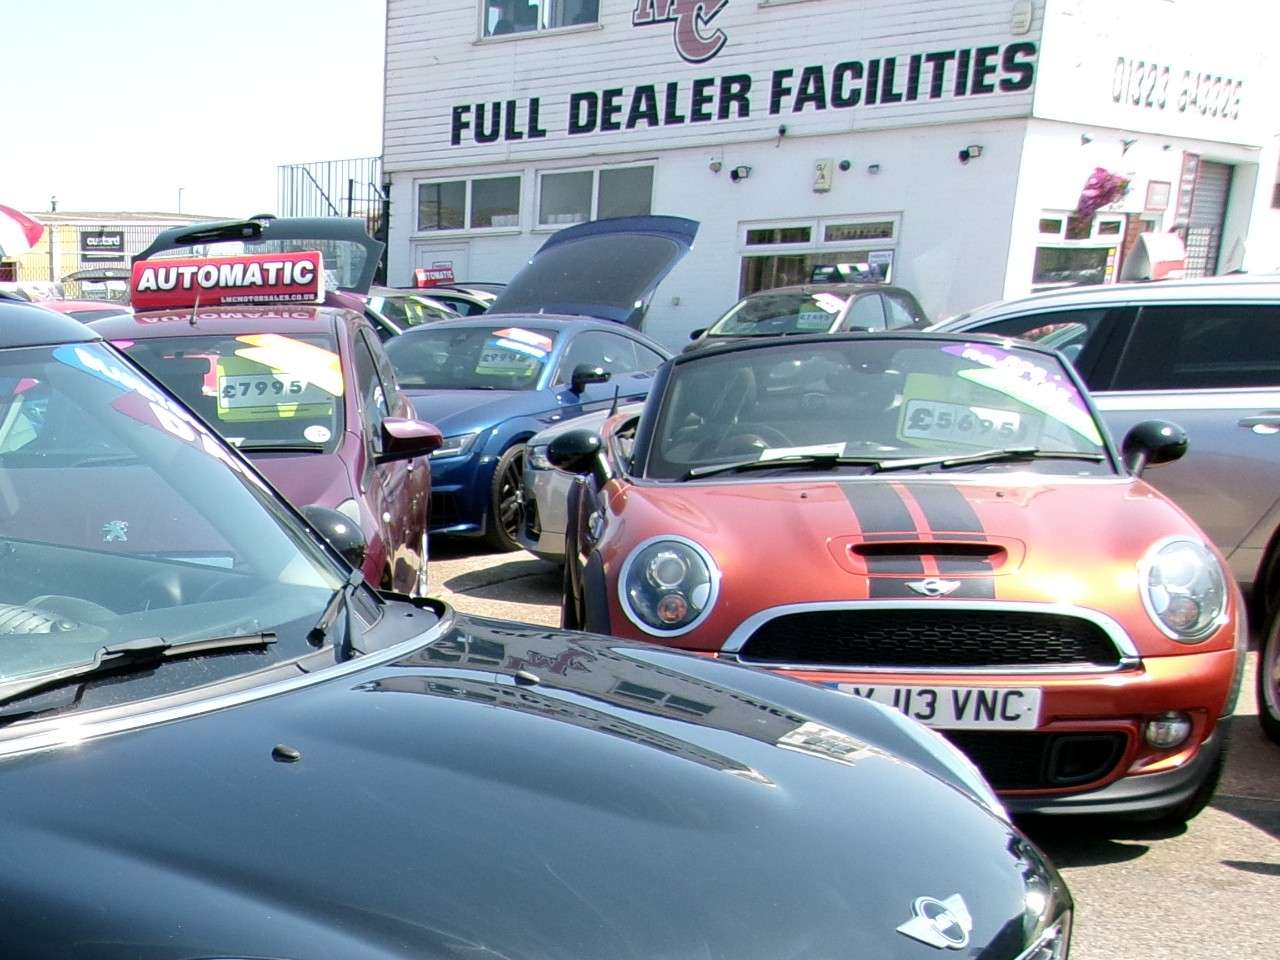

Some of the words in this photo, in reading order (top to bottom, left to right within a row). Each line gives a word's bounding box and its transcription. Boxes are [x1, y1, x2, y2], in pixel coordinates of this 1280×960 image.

[451, 103, 547, 146] FULL
[567, 72, 753, 135] DEALER
[767, 41, 1037, 115] FACILITIES
[1112, 56, 1170, 110] 01323
[137, 260, 315, 292] AUTOMATIC
[222, 380, 302, 399] £7995
[907, 407, 1015, 436] £5695
[951, 688, 1025, 722] VNC
